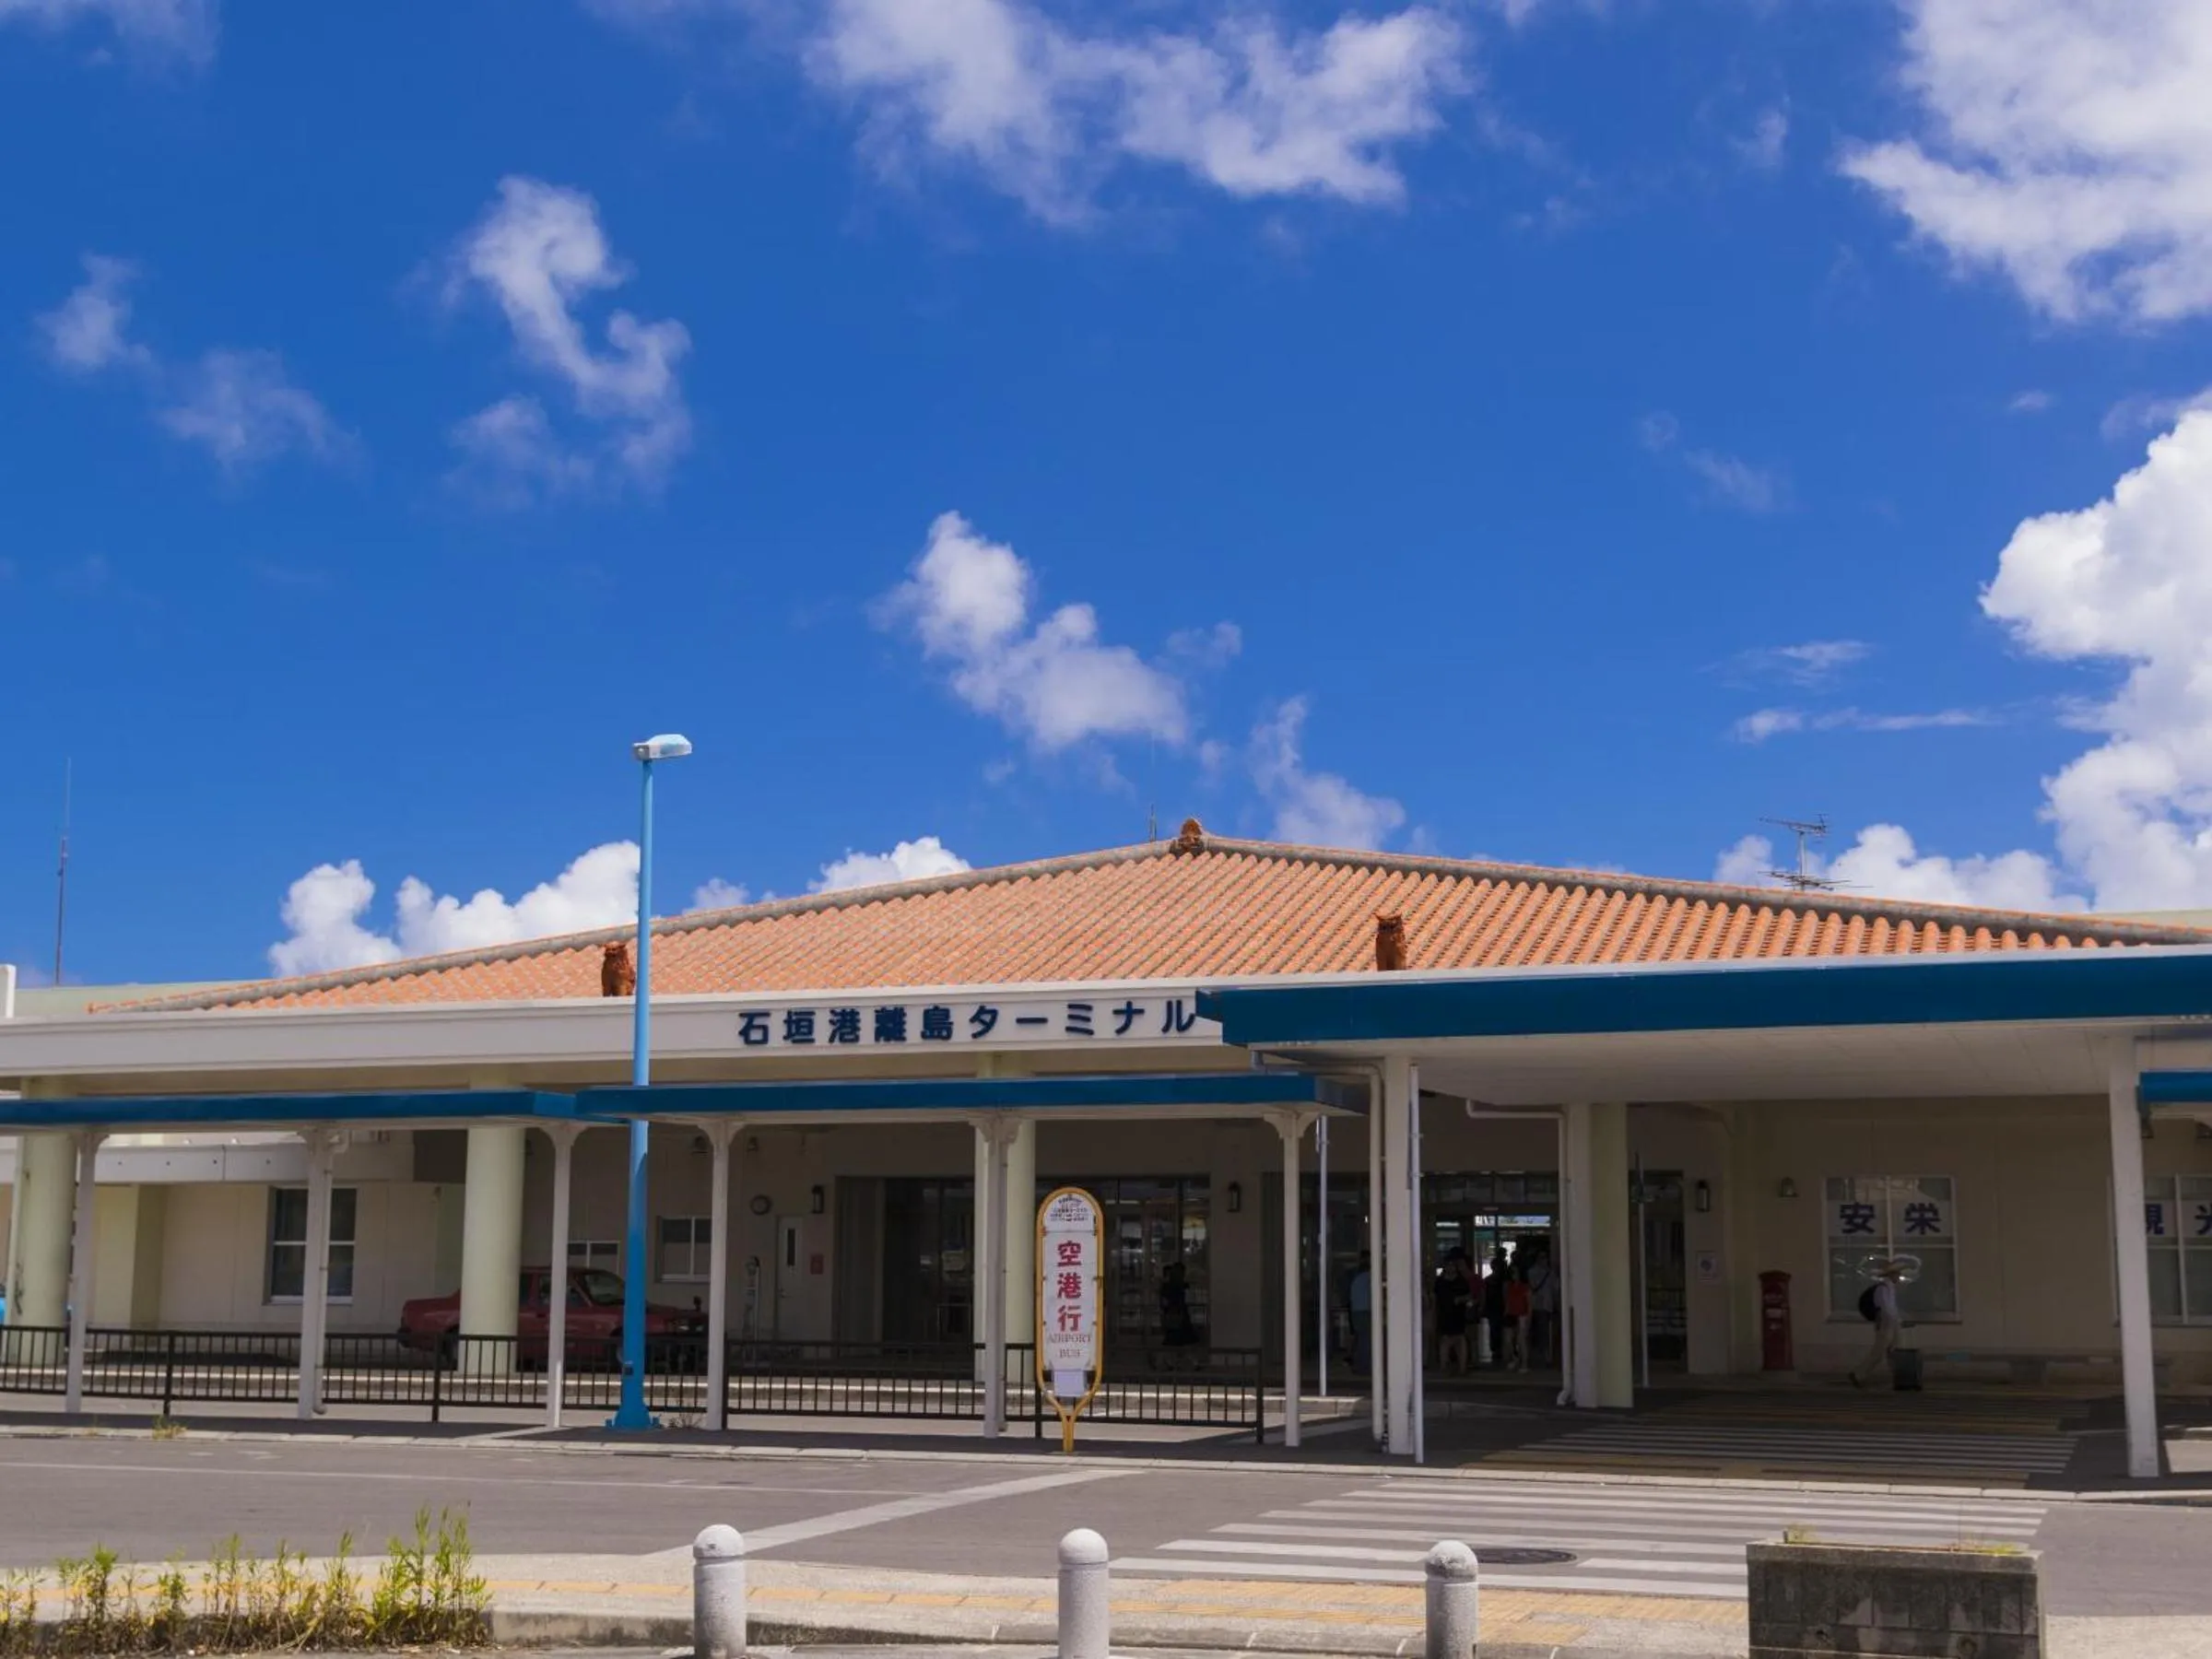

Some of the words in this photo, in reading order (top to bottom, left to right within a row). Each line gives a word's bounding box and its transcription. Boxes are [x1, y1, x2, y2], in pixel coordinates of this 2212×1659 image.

[738, 999, 1196, 1045] 石垣港離島ターミナル
[1840, 1202, 1941, 1235] 安栄
[1057, 1241, 1081, 1332] 空港行
